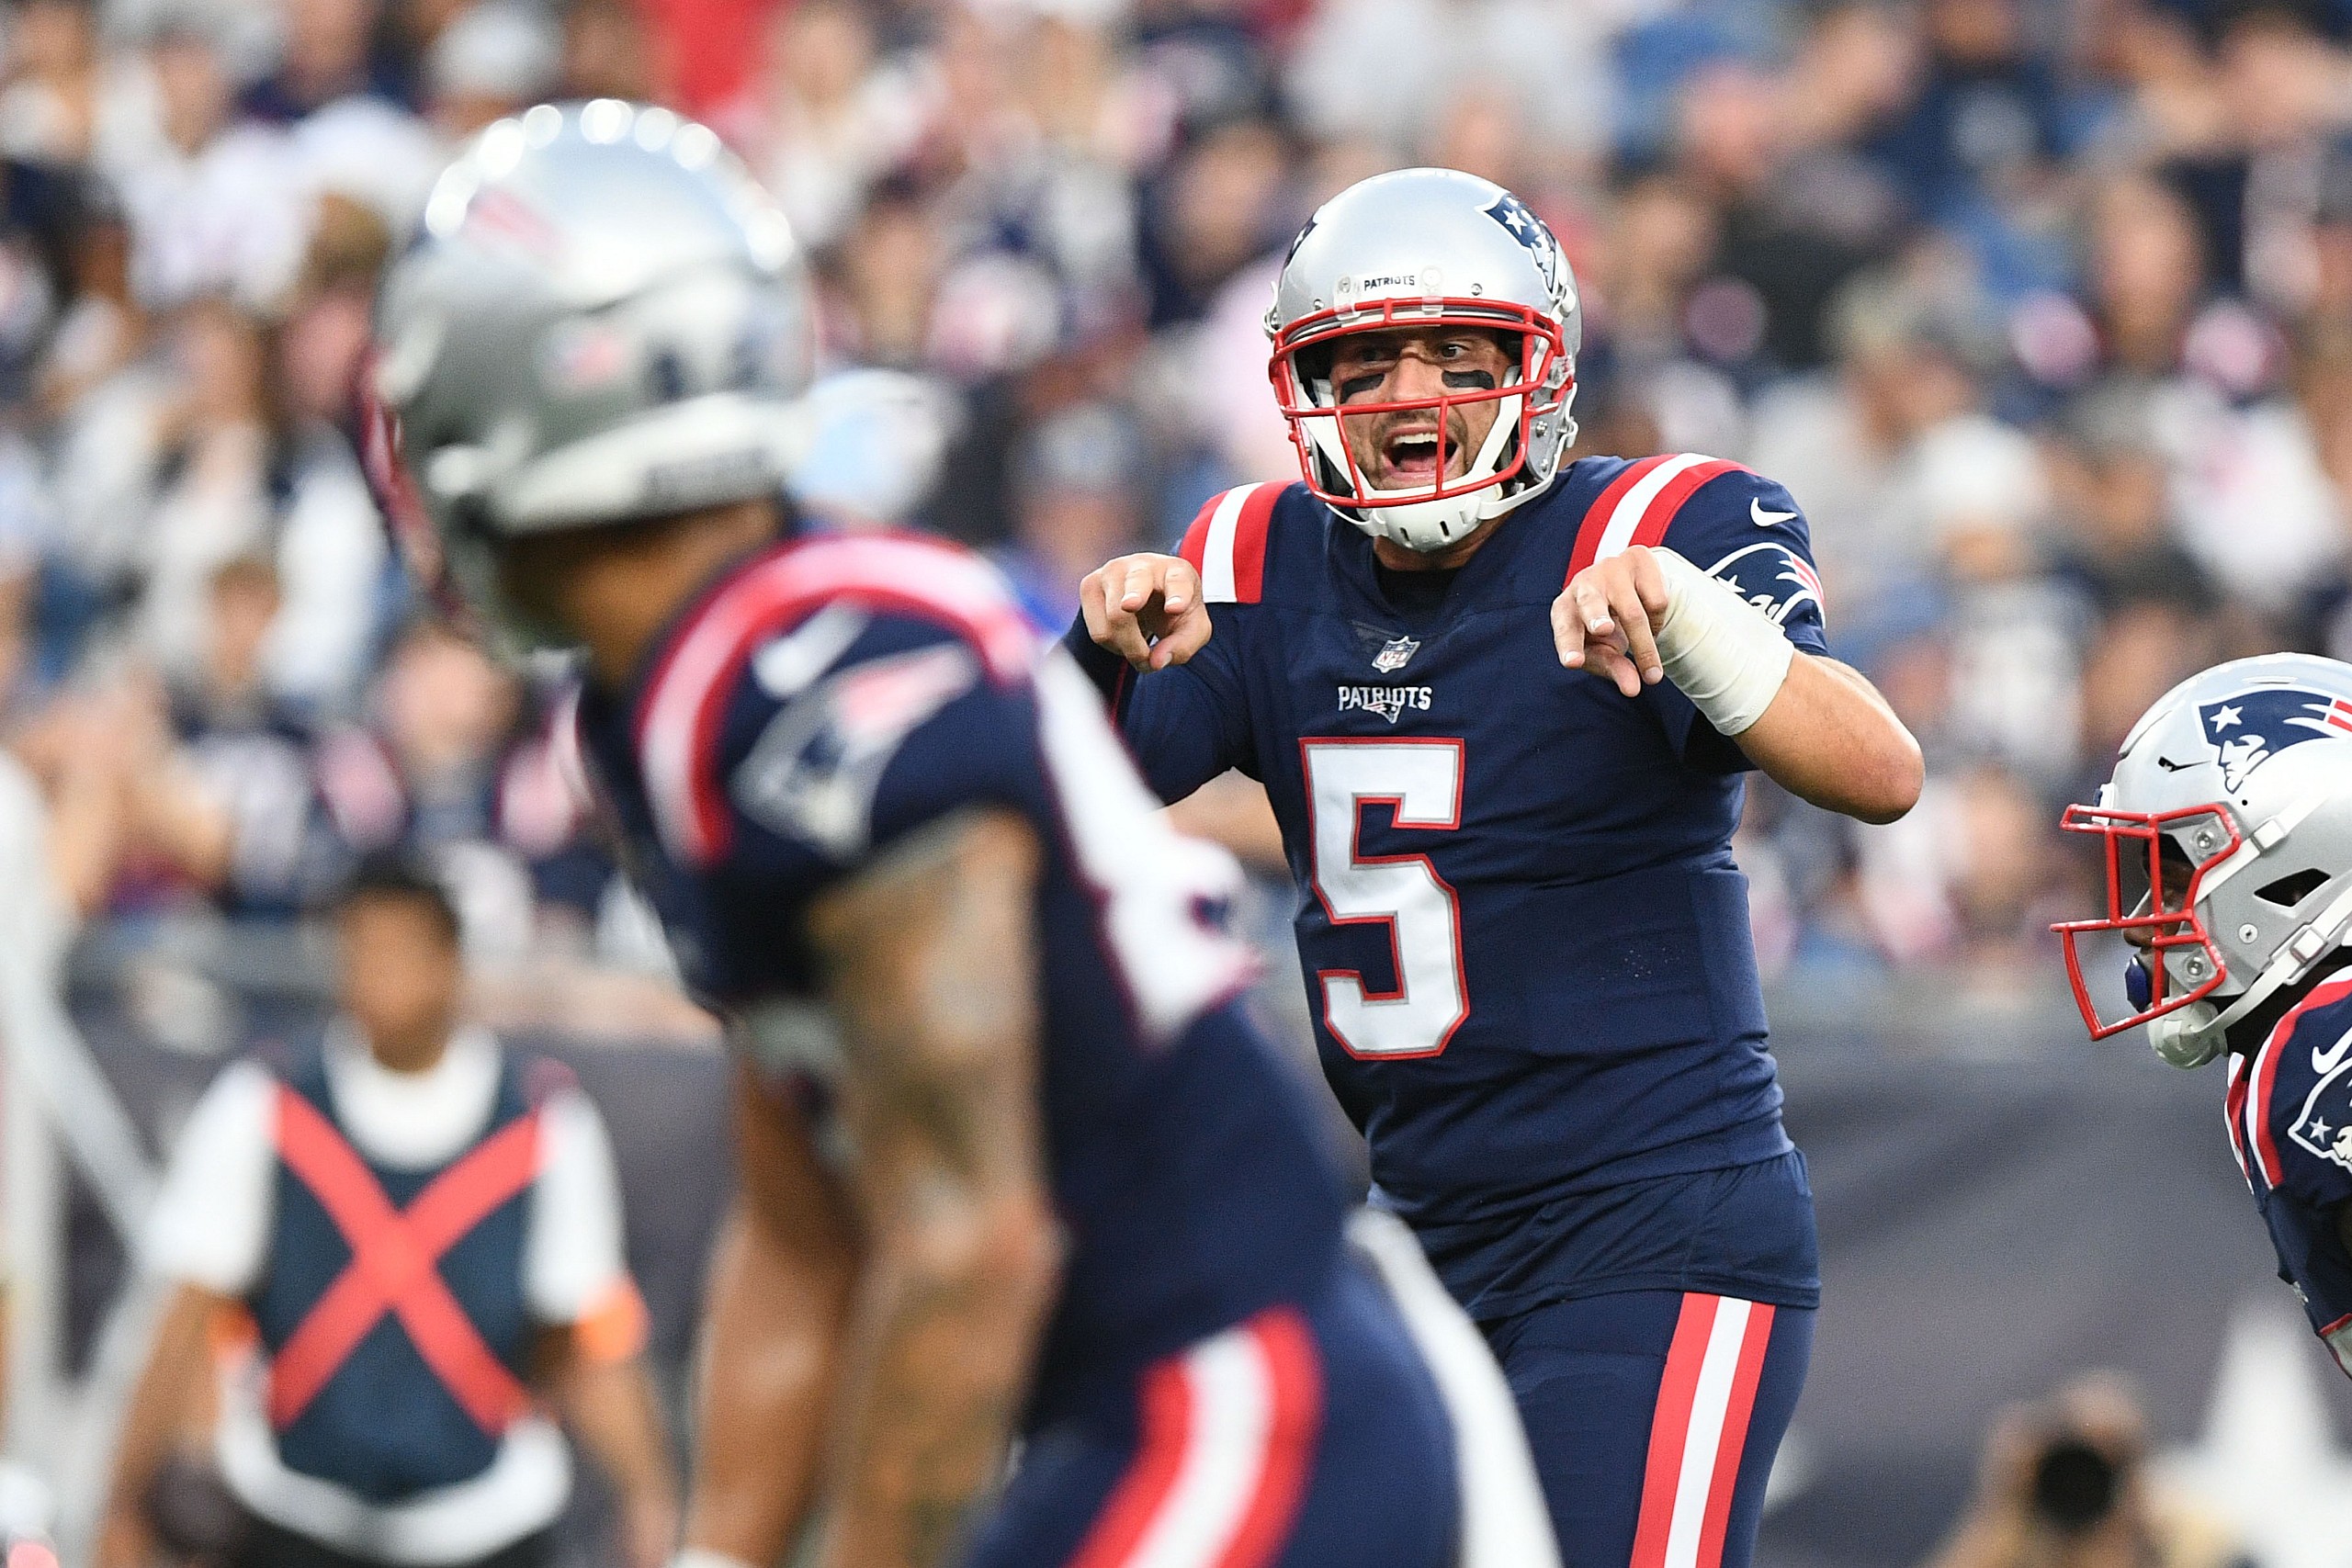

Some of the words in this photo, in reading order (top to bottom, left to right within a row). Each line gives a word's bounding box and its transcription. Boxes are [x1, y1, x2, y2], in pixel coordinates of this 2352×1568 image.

[1363, 275, 1416, 292] PATRIOTS
[1379, 651, 1405, 665] NFL
[1338, 685, 1433, 711] PATRIOTS
[1297, 737, 1470, 1061] 5
